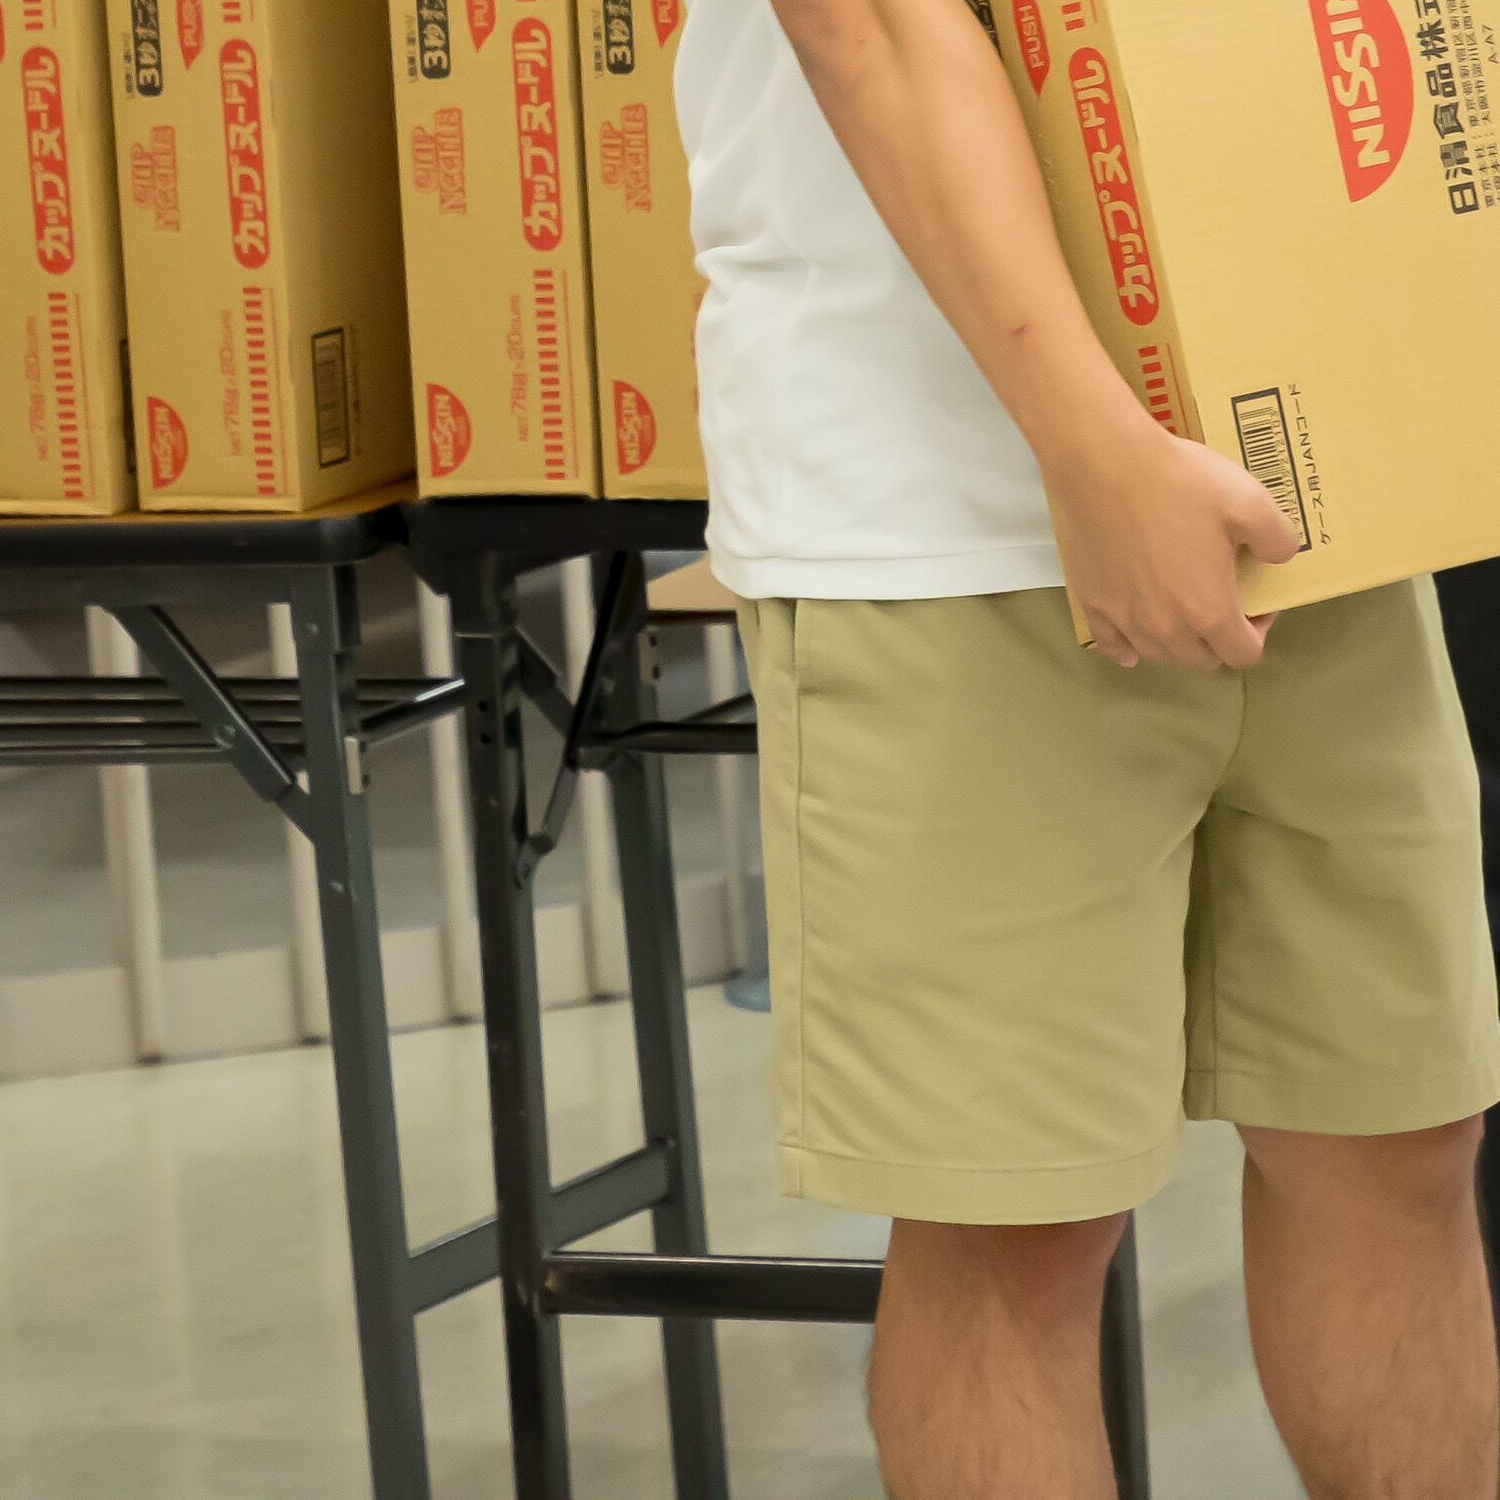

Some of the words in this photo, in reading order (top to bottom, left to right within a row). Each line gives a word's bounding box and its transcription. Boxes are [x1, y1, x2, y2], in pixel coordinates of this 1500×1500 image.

[513, 29, 559, 238] カップヌードル
[1018, 4, 1046, 69] PUSH
[25, 56, 72, 260] カップヌードル
[223, 49, 267, 254] カップヌードル
[1073, 59, 1156, 308] カップヌードル
[1287, 383, 1332, 546] ケース用JANコード
